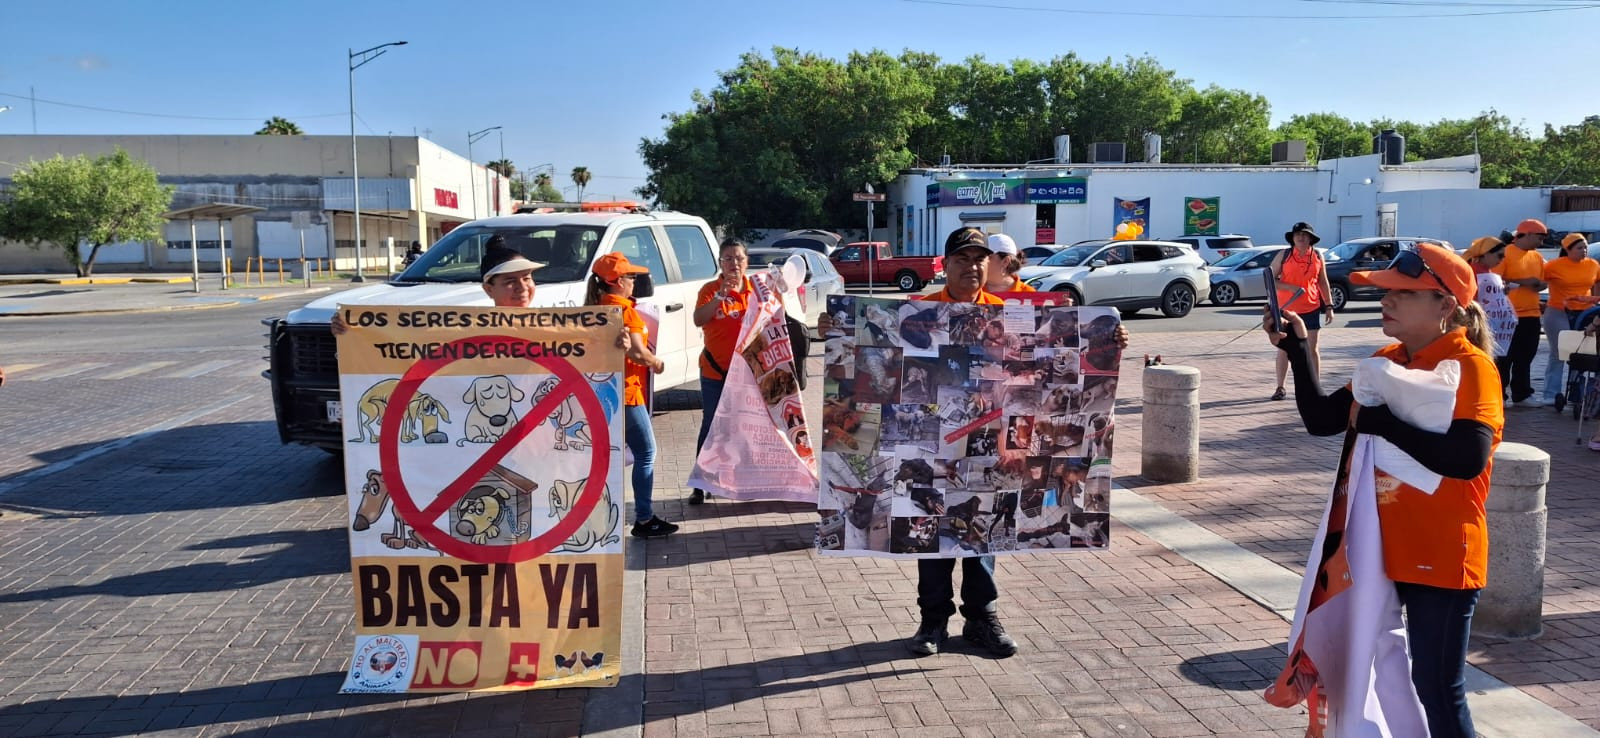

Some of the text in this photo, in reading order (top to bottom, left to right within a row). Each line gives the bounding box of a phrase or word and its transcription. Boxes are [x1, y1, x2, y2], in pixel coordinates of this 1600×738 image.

[345, 309, 608, 328] LOS SERES SINTIENTES
[768, 327, 782, 341] LA
[375, 341, 585, 360] TIENEN DERECHOS
[358, 562, 600, 629] BASTA YA
[355, 636, 408, 668] NO AL MALTRATO
[414, 647, 479, 686] NO
[359, 680, 393, 689] ANIMAL
